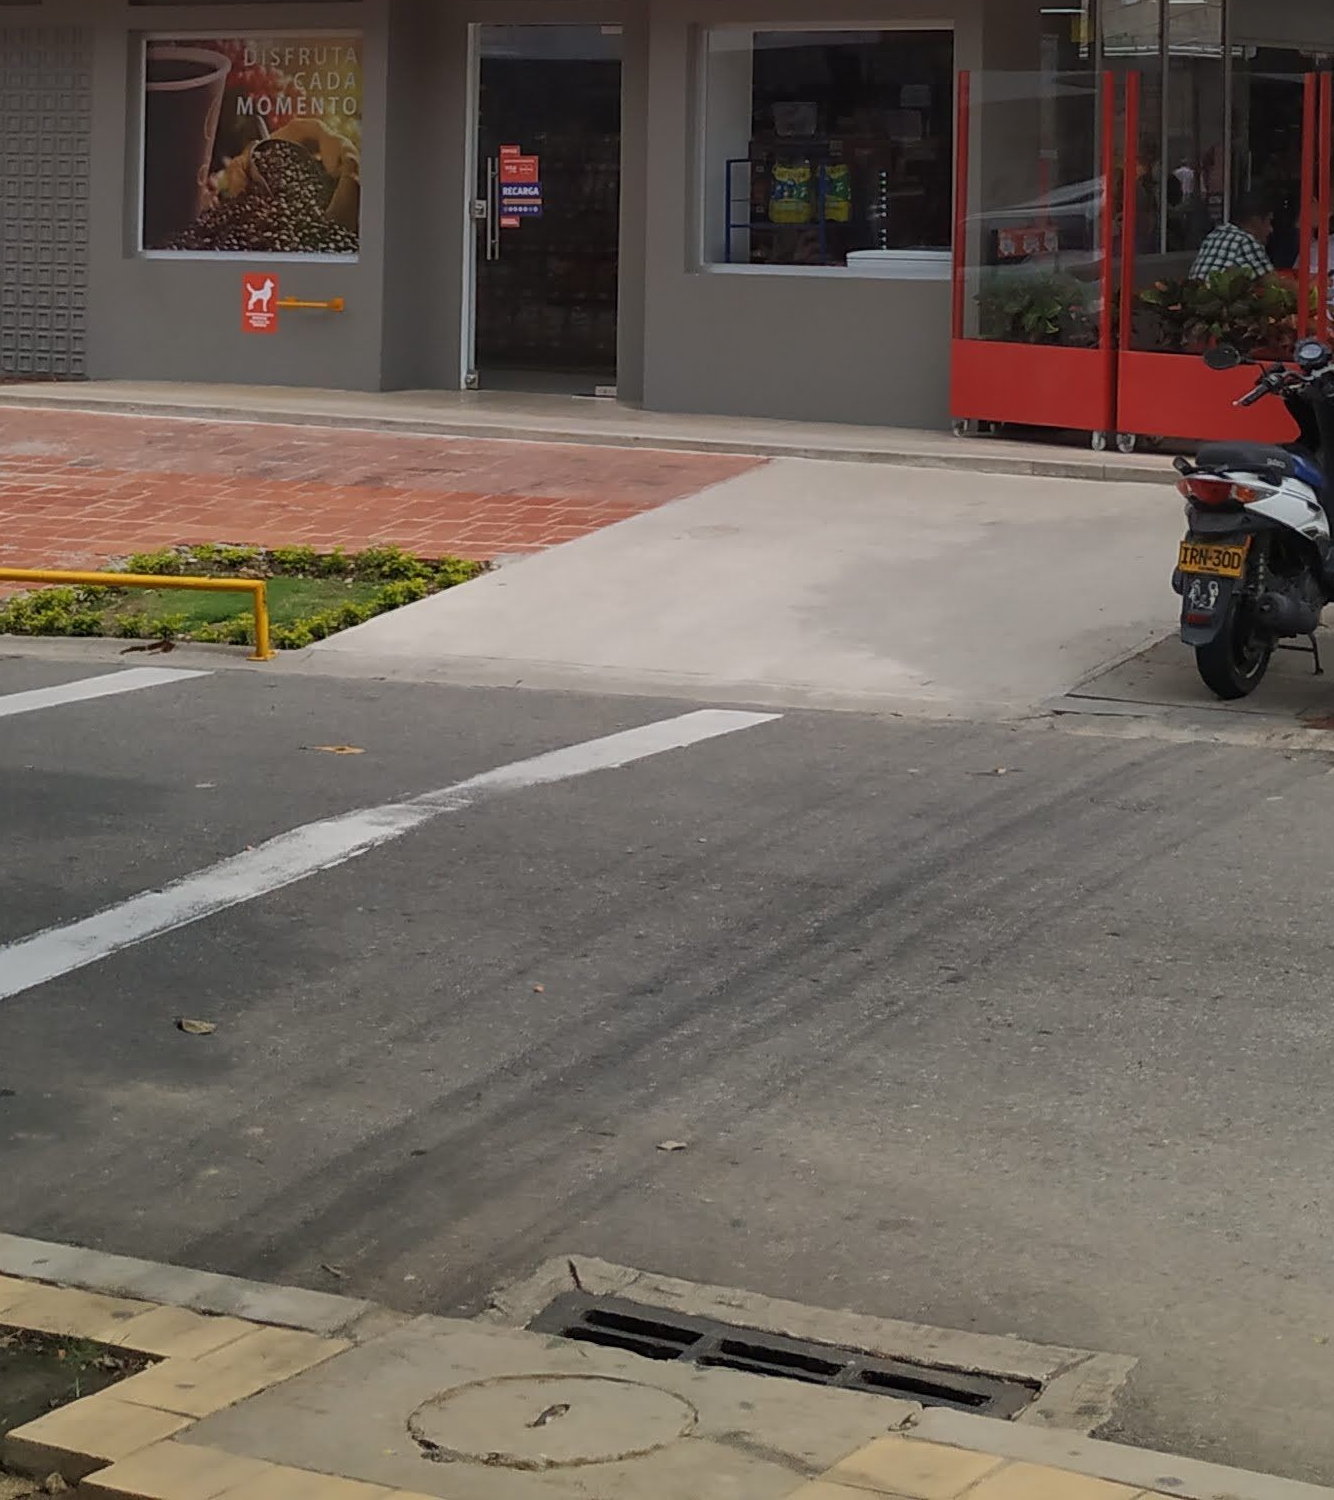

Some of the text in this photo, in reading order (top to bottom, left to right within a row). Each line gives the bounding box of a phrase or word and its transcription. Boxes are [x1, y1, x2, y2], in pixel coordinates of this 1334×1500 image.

[243, 46, 358, 67] DISFRUTA
[293, 71, 357, 91] CADA
[235, 95, 358, 116] MOMENTO
[502, 186, 540, 196] RECARGA
